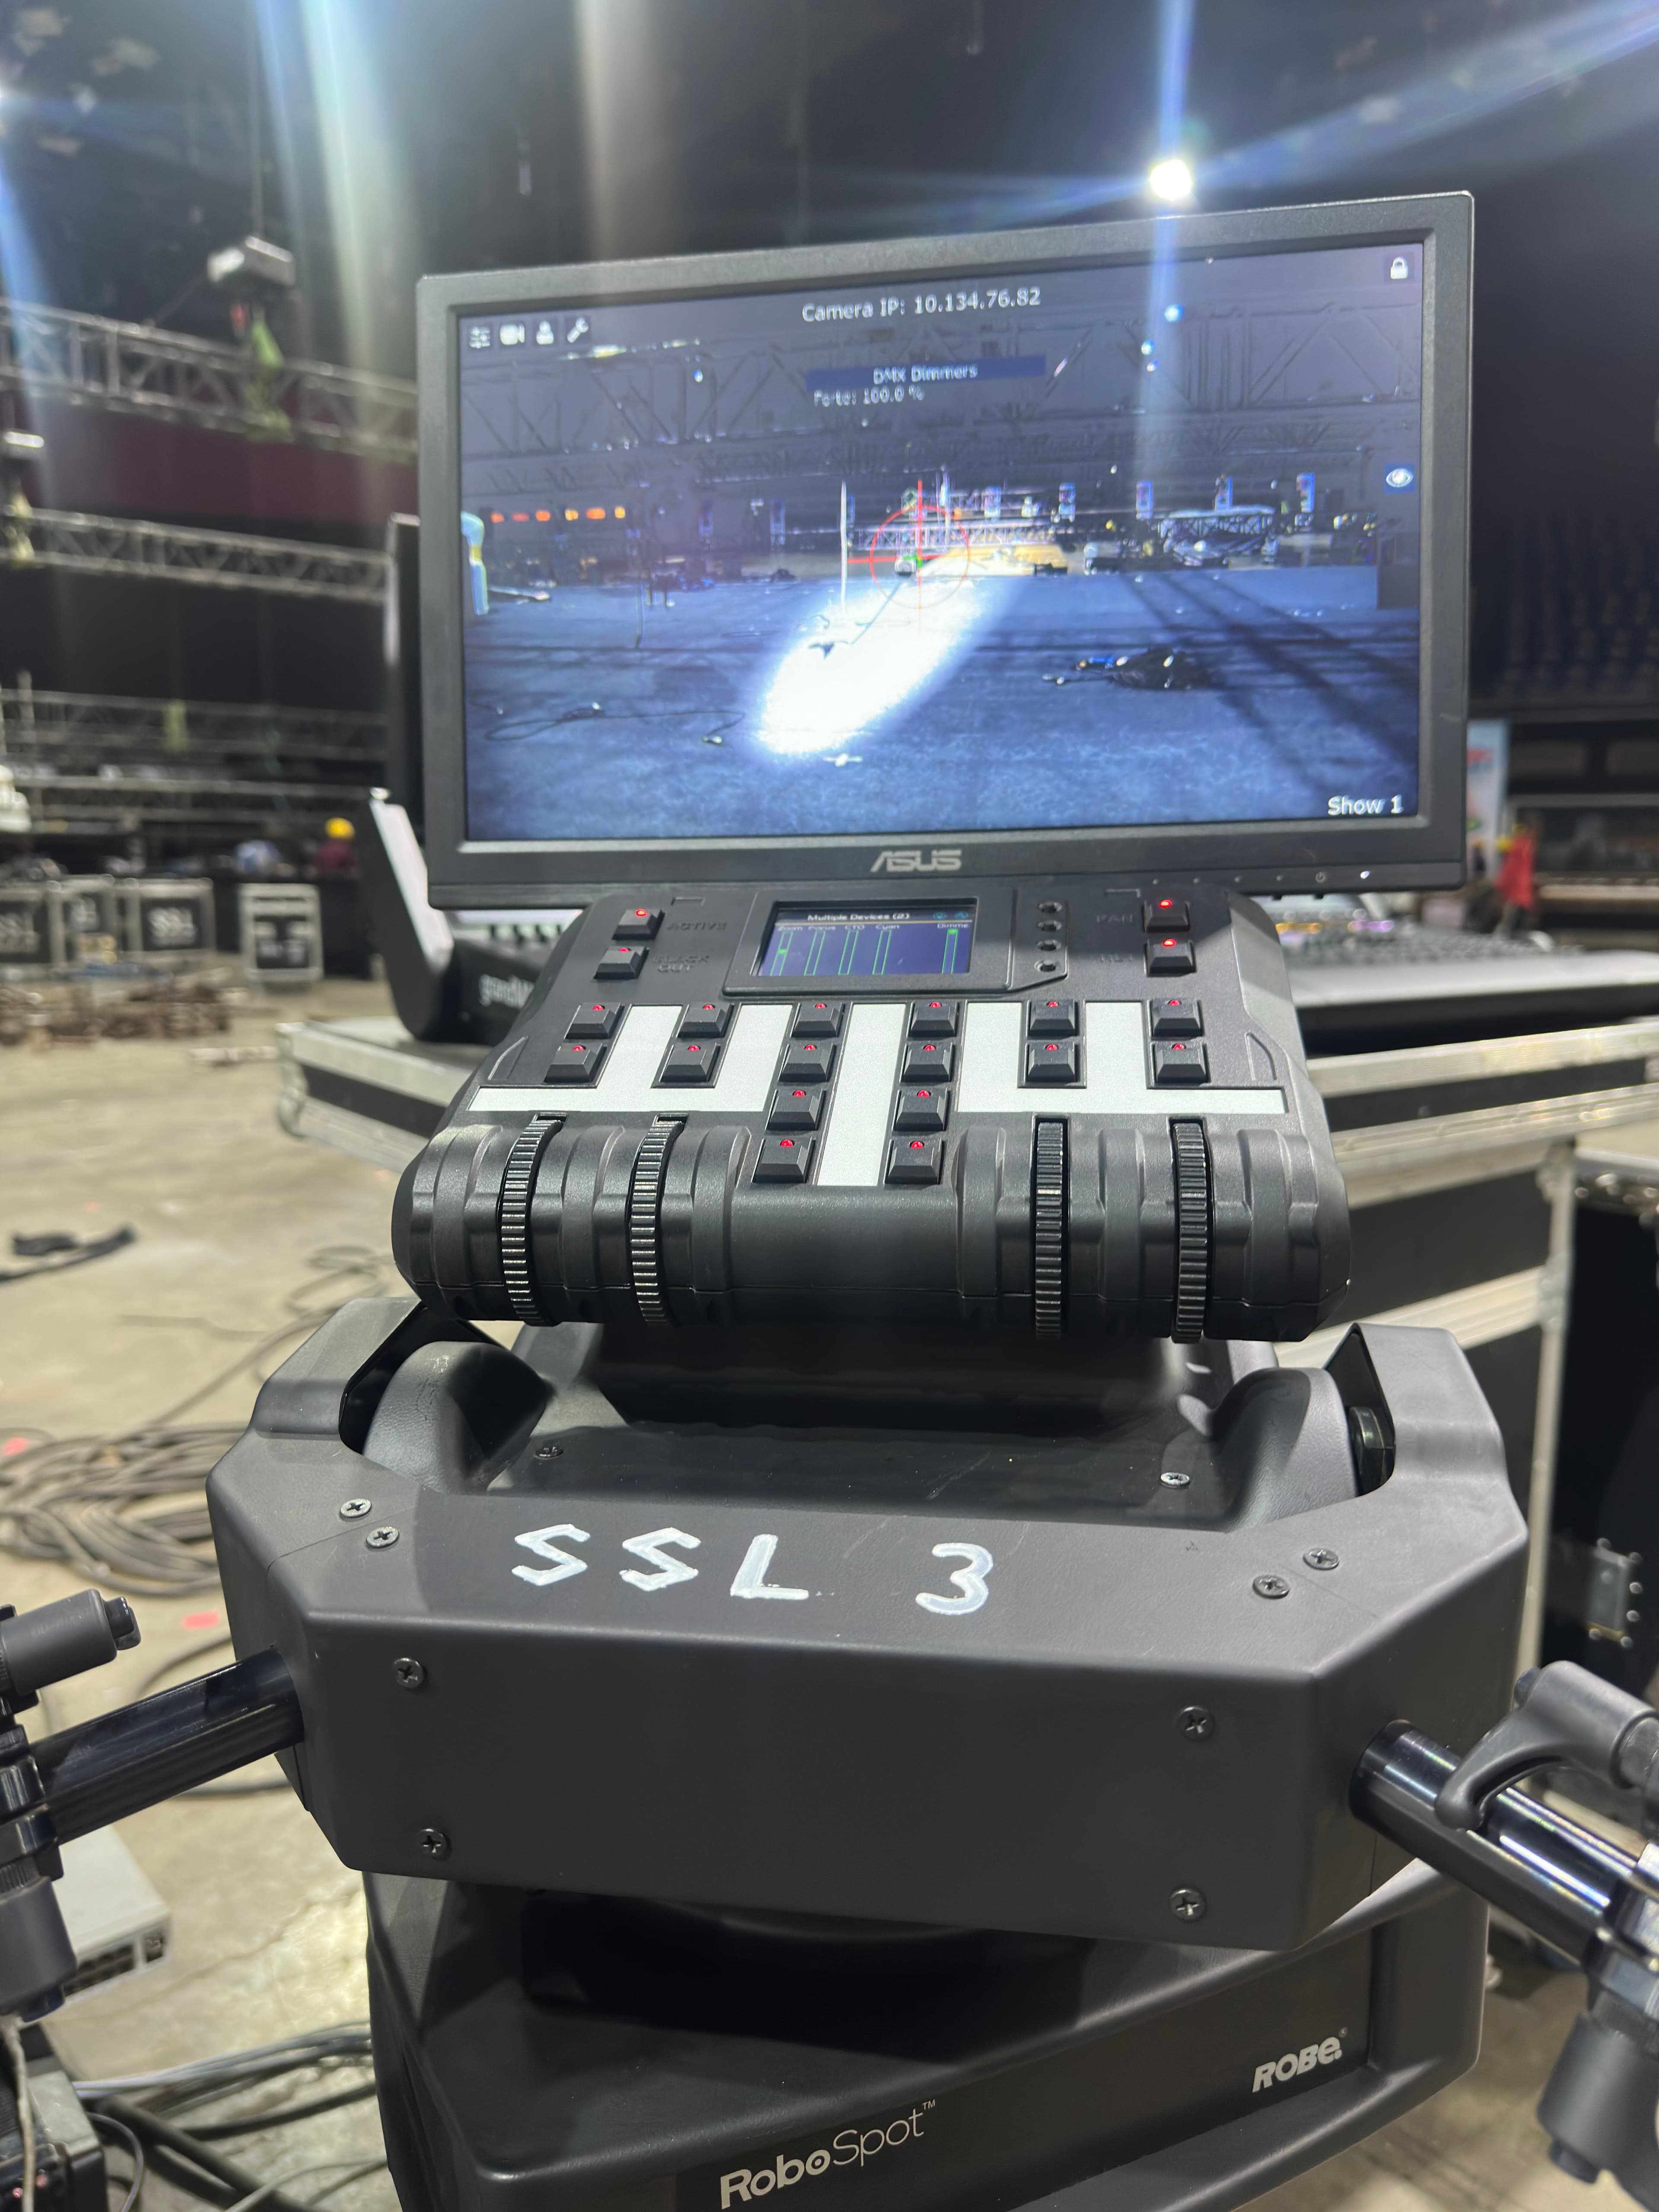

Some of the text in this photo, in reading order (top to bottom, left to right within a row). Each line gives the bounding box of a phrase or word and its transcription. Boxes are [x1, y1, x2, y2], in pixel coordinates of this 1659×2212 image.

[802, 287, 1041, 322] Camera IP: 10.134.76.82
[874, 363, 978, 385] DMX Dimmers
[863, 385, 904, 404] 100.0
[909, 385, 925, 401] %
[1328, 794, 1403, 816] Show 1
[870, 849, 962, 873] ASUS
[667, 922, 728, 930] ACTIVE
[658, 964, 694, 973] OUT
[915, 1543, 994, 1615] 3
